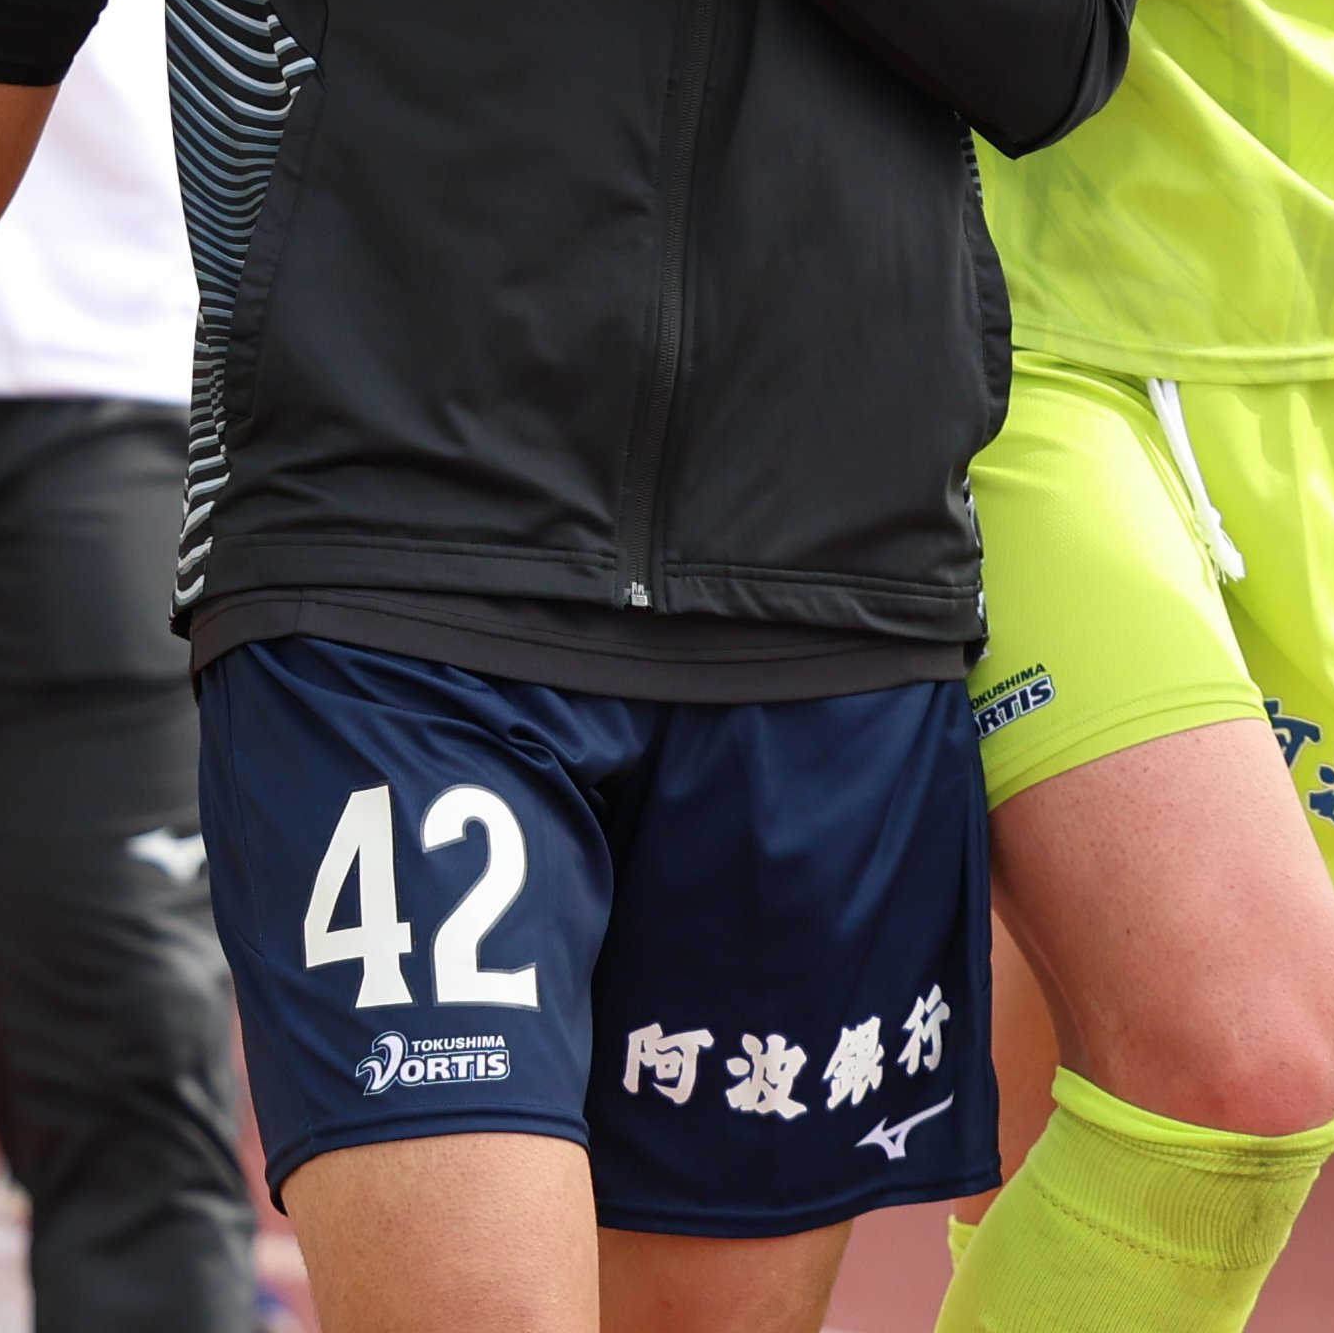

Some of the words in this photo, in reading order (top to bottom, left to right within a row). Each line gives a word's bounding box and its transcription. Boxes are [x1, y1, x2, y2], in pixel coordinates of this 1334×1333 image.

[303, 783, 540, 1011] 42
[356, 1031, 510, 1095] VORTIS
[412, 1035, 506, 1052] TOKUSHIMA
[624, 983, 951, 1120] 阿波銀行
